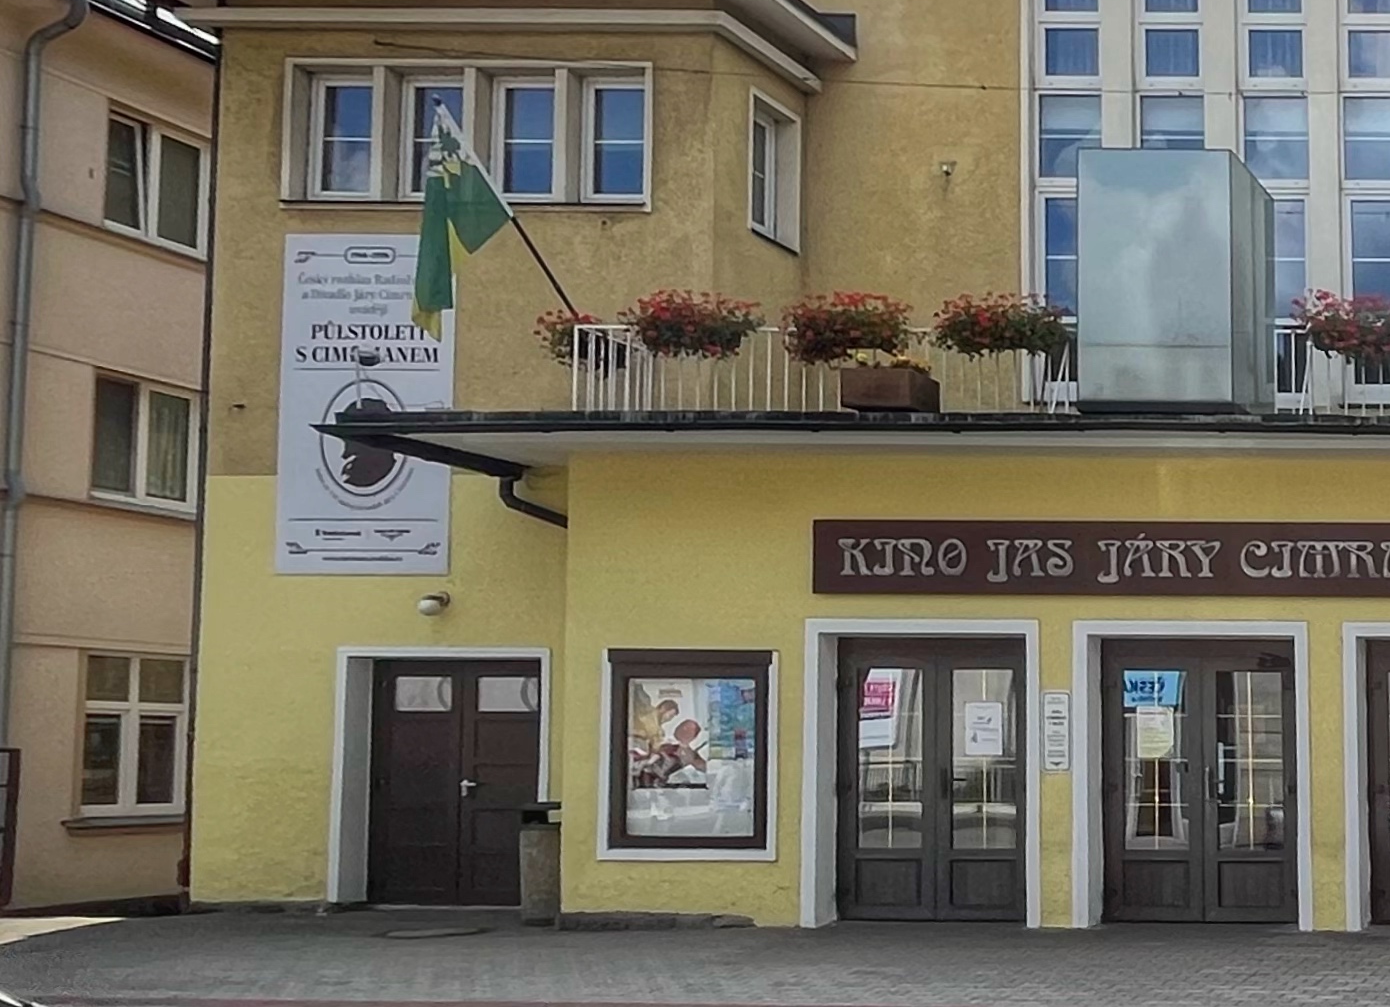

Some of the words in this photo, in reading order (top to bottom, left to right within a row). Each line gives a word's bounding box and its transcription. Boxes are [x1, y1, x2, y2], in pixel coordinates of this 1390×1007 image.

[295, 346, 307, 363] S
[311, 345, 440, 364] CIMANEM
[838, 537, 968, 576] KINO
[986, 538, 1075, 583] JAS
[1097, 532, 1221, 584] JÁRY
